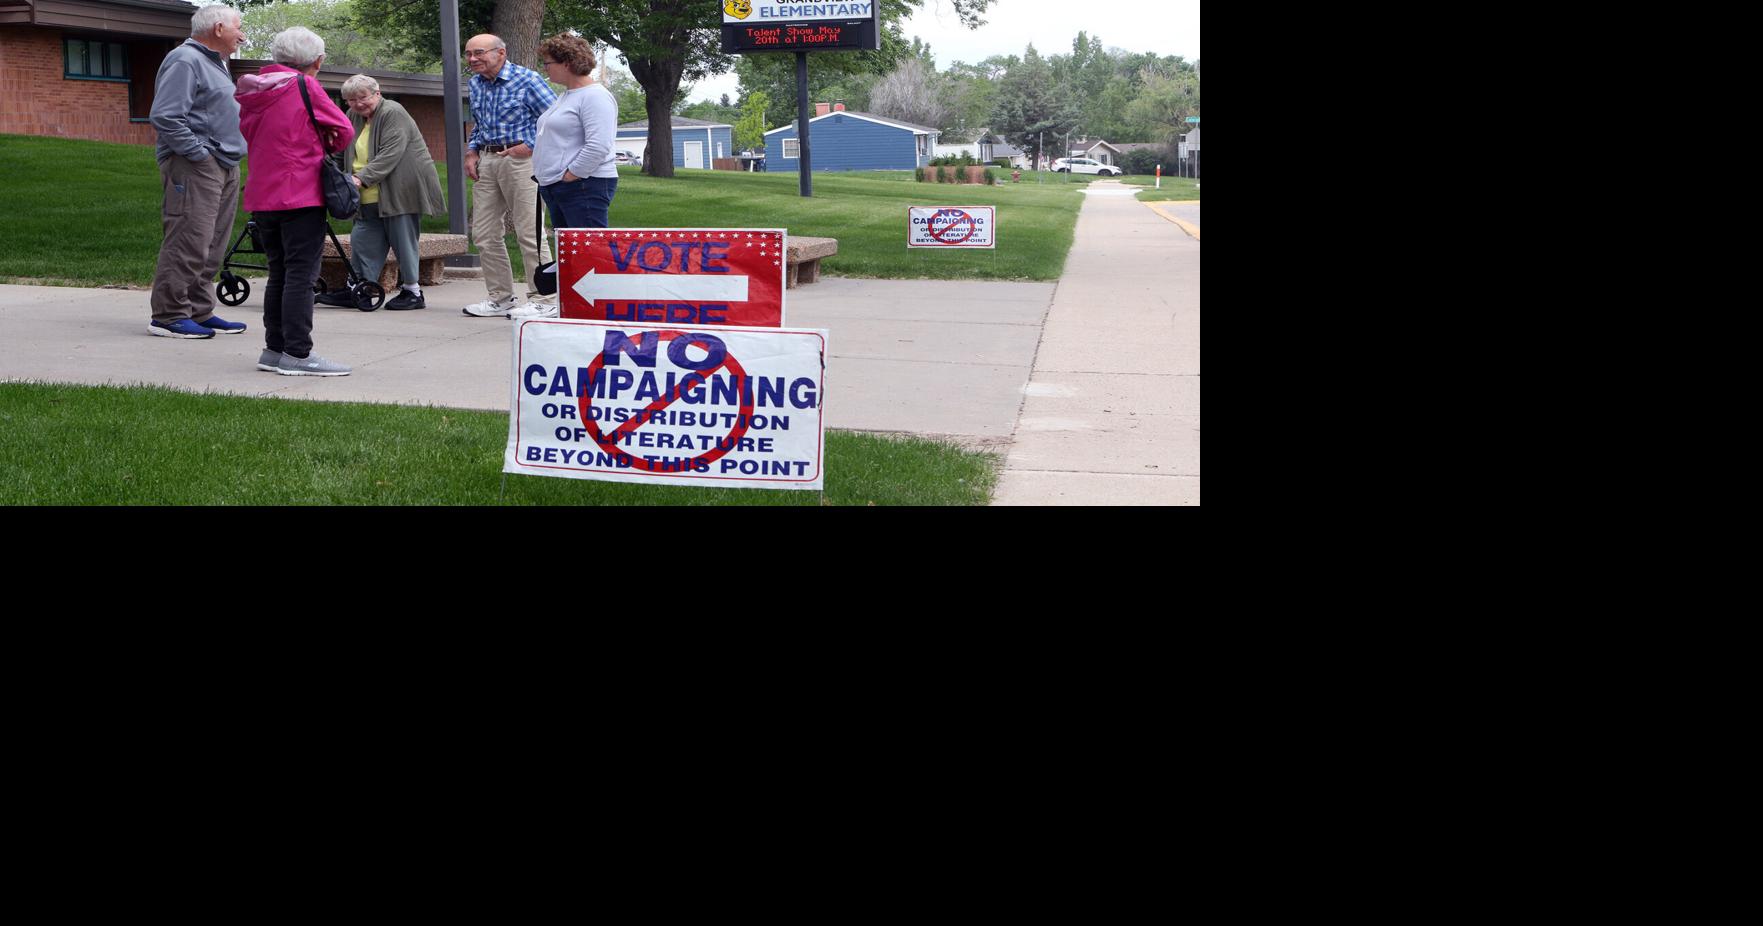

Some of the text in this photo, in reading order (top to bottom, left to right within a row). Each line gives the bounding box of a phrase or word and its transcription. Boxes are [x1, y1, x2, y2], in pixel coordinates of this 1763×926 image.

[760, 3, 871, 18] ELEMENTARY
[746, 26, 841, 37] Talent Show May
[755, 35, 779, 45] 20th
[785, 35, 796, 44] at
[913, 217, 984, 225] CAMPAIGNING
[937, 209, 965, 217] NO
[608, 241, 730, 273] VOTE
[602, 329, 728, 371] NO
[523, 364, 817, 410] CAMPAIGNING
[541, 402, 790, 431] OR DISTRIBUTION
[554, 426, 774, 453] OF LITERATURE
[526, 446, 810, 476] BEYOND THIS POINT
